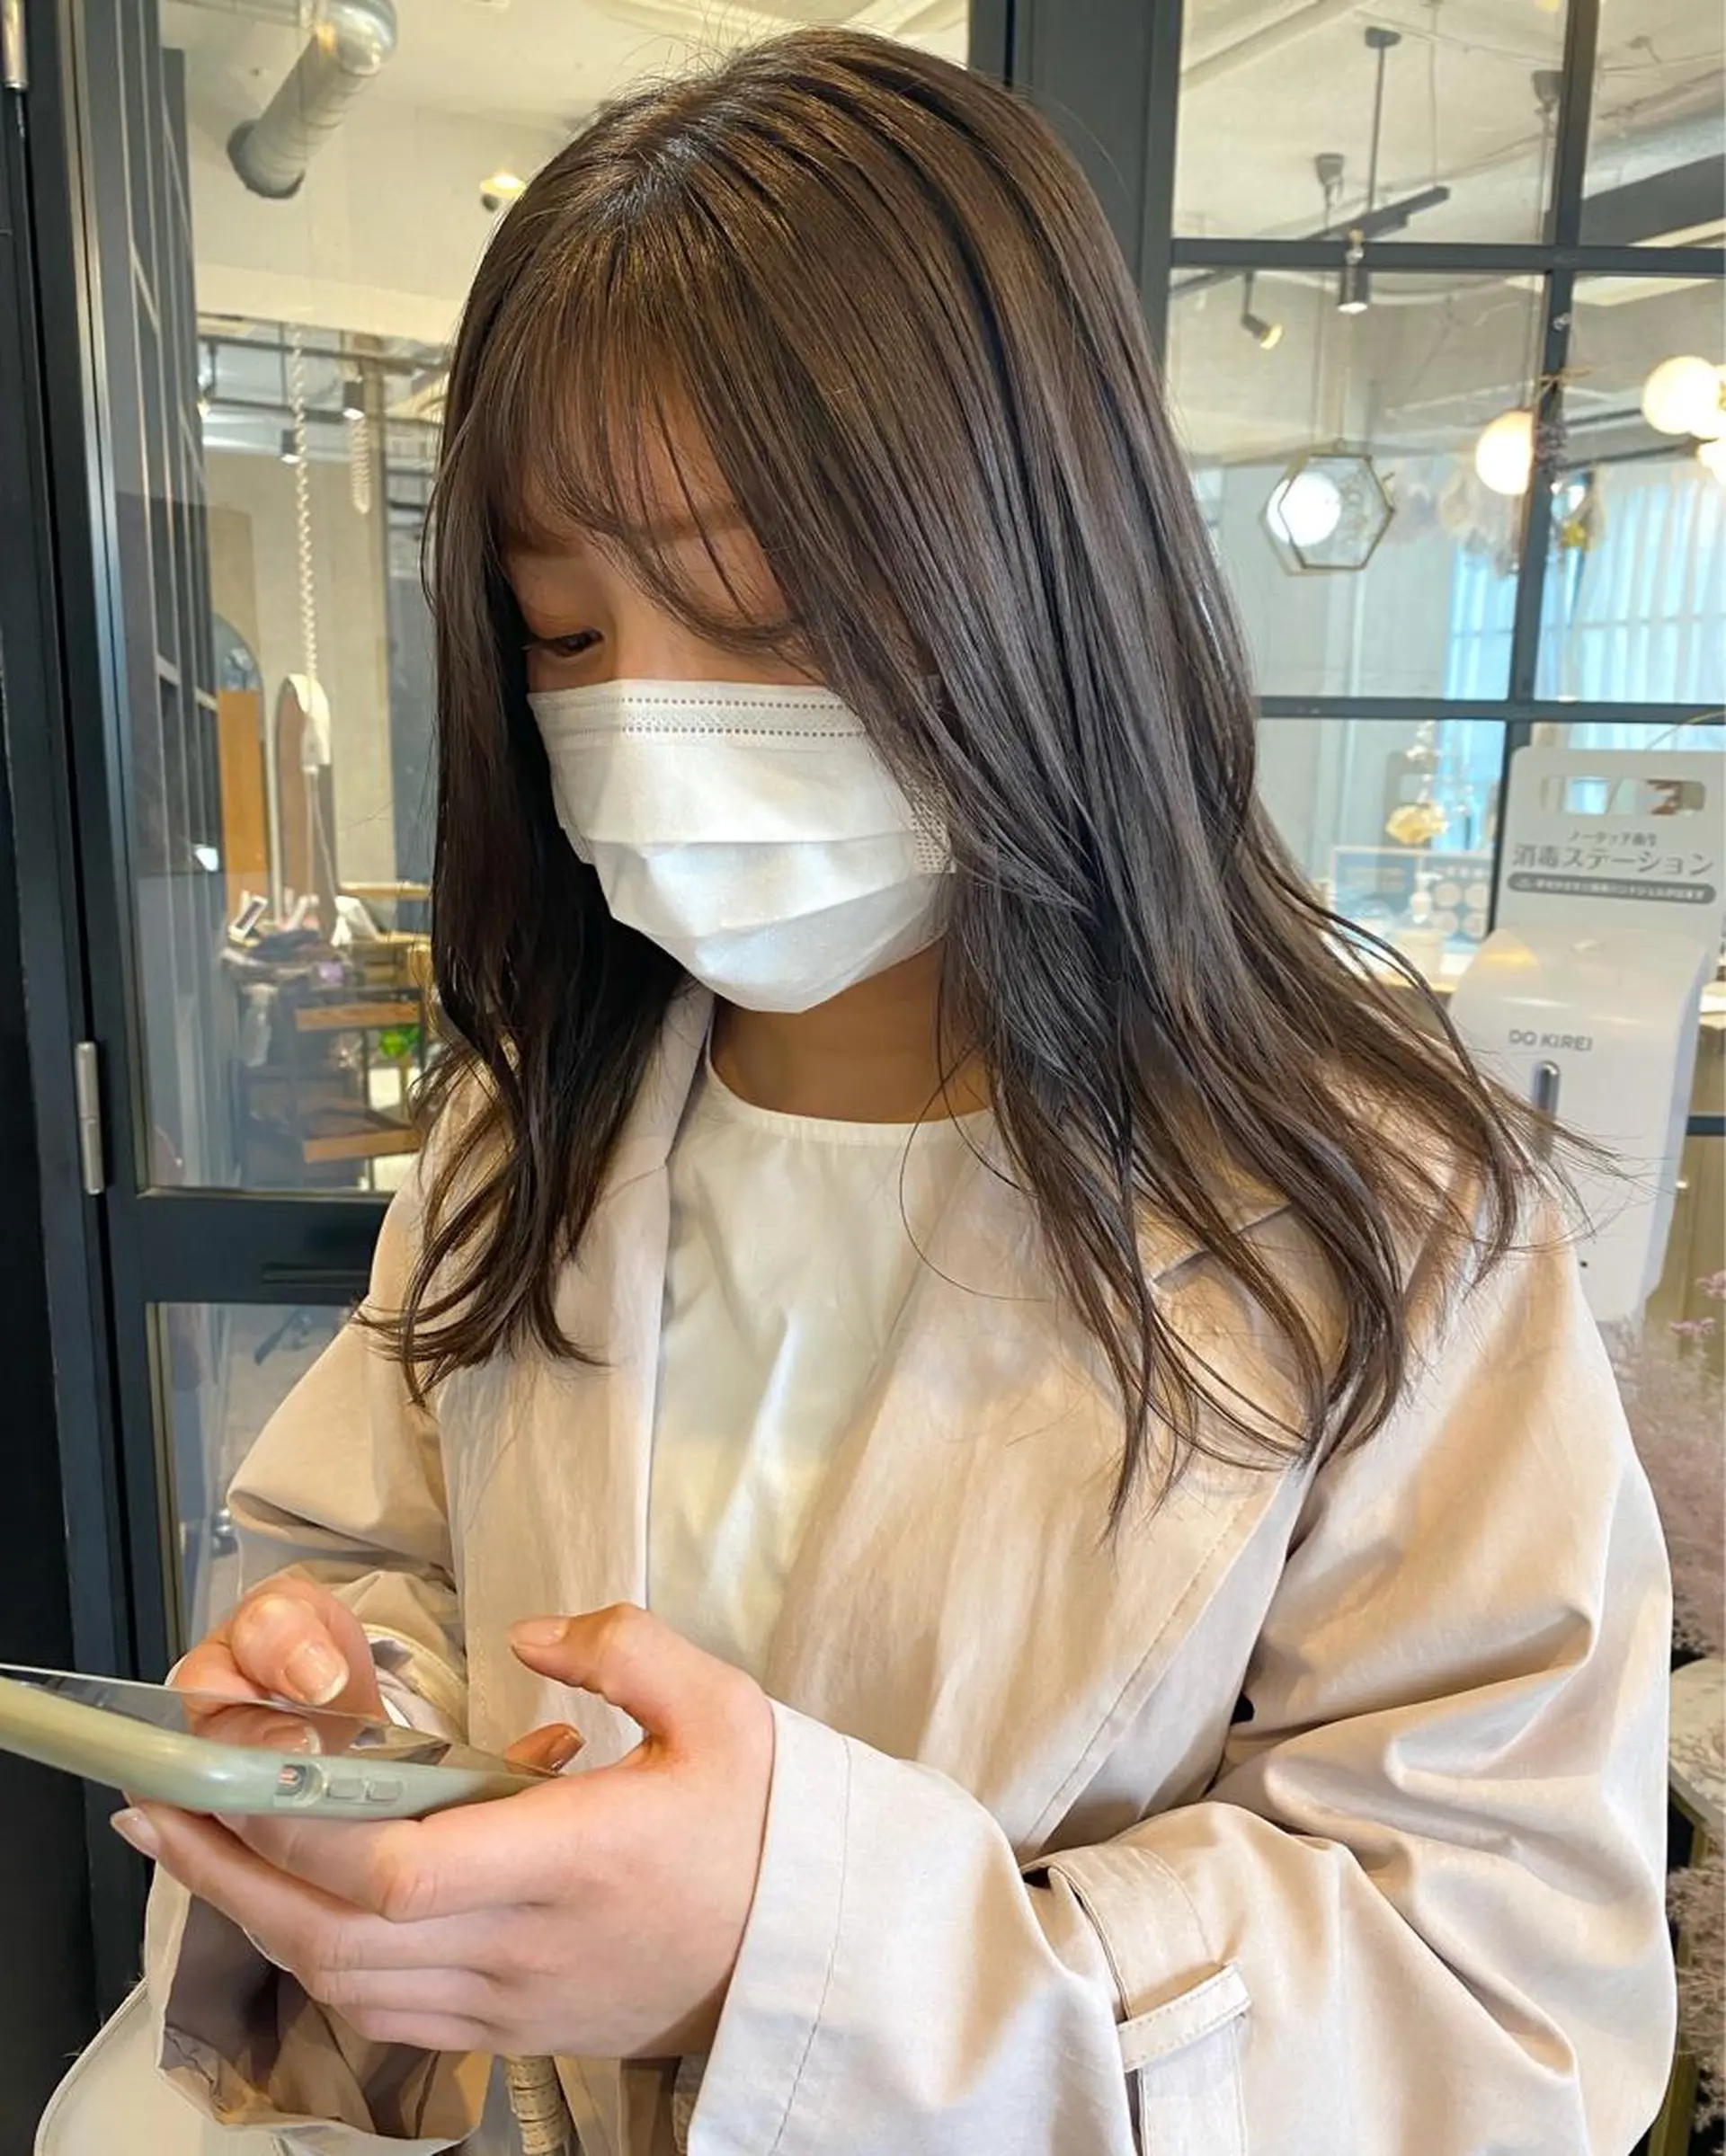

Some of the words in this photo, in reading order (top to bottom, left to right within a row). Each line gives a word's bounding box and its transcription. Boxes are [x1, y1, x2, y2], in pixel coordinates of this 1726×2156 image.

[1513, 844, 1714, 877] 消毒ステーション
[1508, 1029, 1538, 1047] DO
[1540, 1033, 1594, 1051] KIREI
